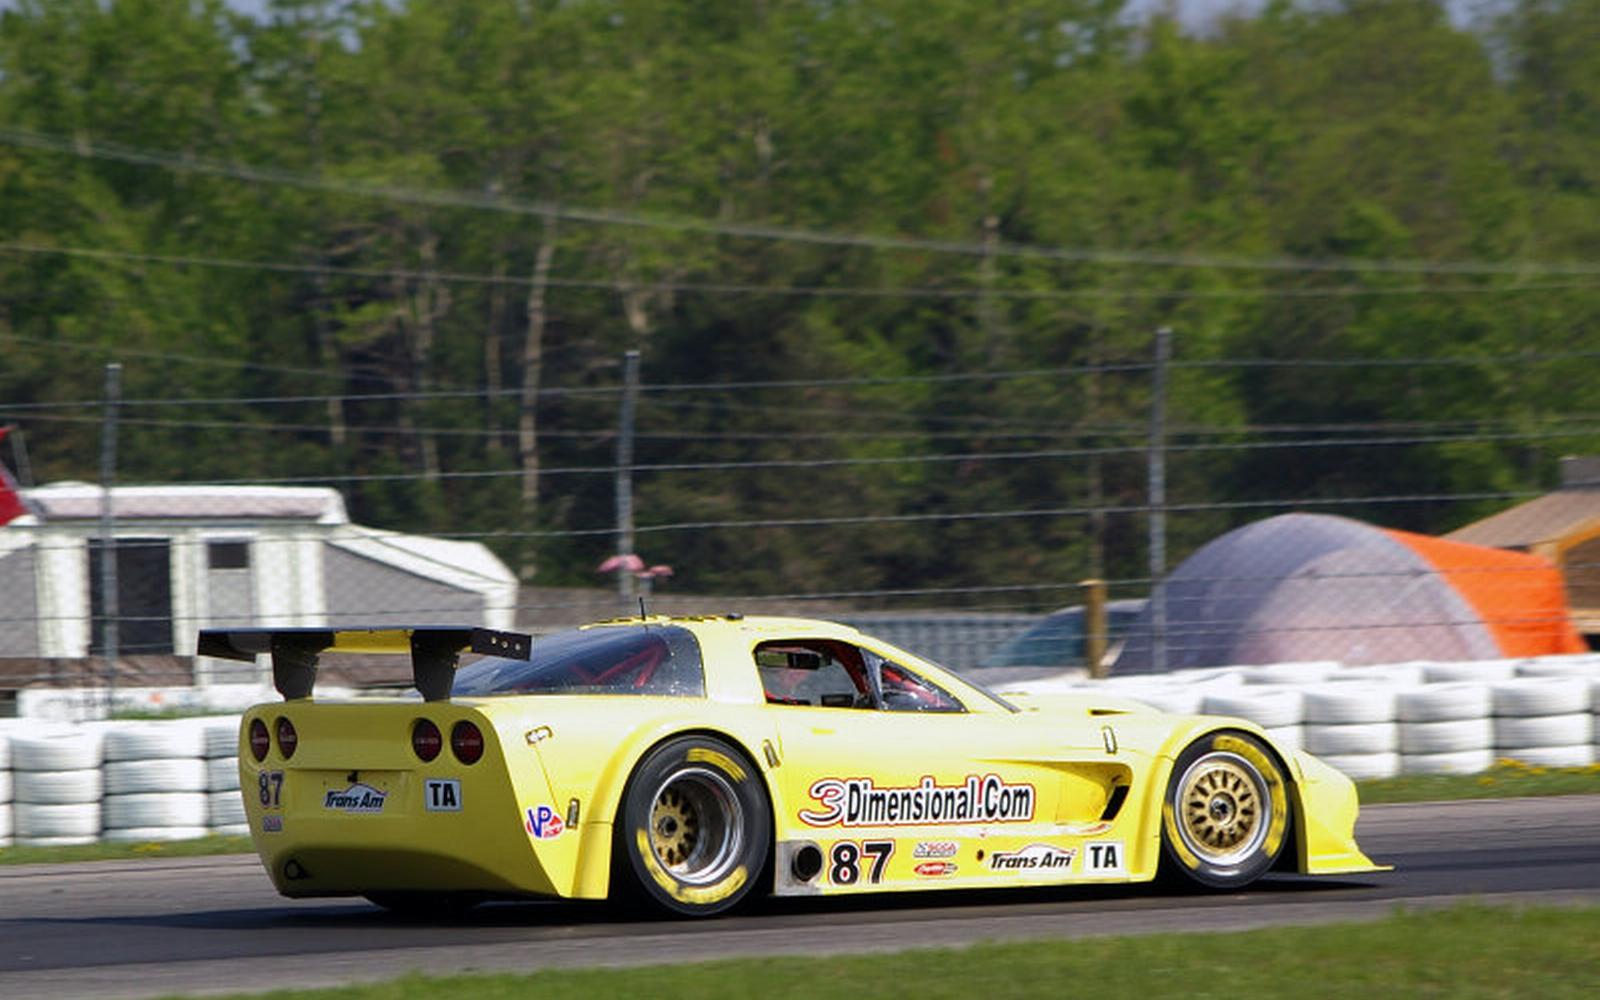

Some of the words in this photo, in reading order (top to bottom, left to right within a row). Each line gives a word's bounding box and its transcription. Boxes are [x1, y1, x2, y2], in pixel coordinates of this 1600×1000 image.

[258, 771, 284, 806] 87
[325, 791, 359, 808] Trans
[359, 791, 385, 808] Am
[429, 783, 457, 807] TA
[527, 806, 552, 838] VP
[830, 842, 894, 885] 87
[991, 853, 1038, 869] Trans
[1039, 851, 1073, 868] Am
[1089, 845, 1118, 869] TA
